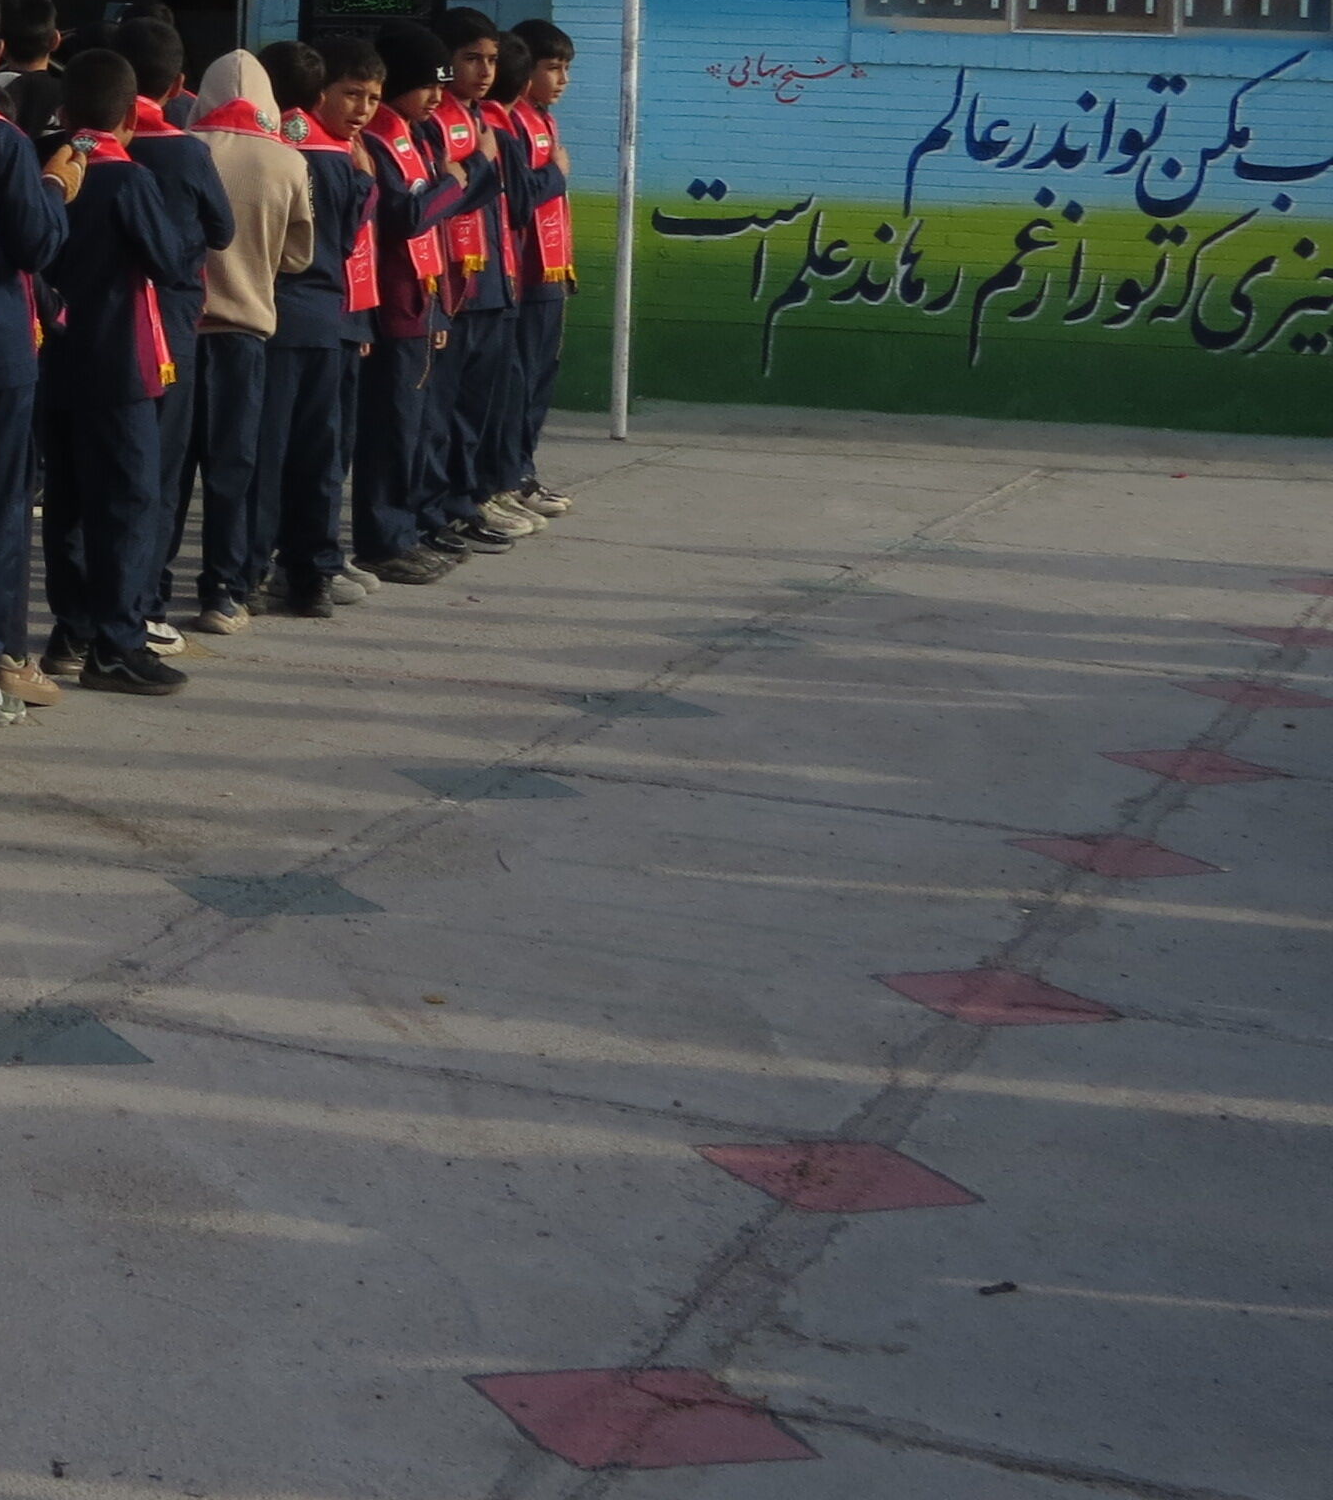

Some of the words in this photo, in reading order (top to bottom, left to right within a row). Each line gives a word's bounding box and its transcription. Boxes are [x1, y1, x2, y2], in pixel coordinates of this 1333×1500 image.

[775, 56, 846, 103] شیخ
[1105, 74, 1188, 175] تو
[1135, 50, 1310, 218] مکن
[903, 66, 1011, 218] عالم
[652, 178, 815, 302] است
[761, 209, 856, 378] علم
[829, 218, 964, 316] رهاند
[969, 186, 1060, 368] غم
[1149, 208, 1260, 324] که
